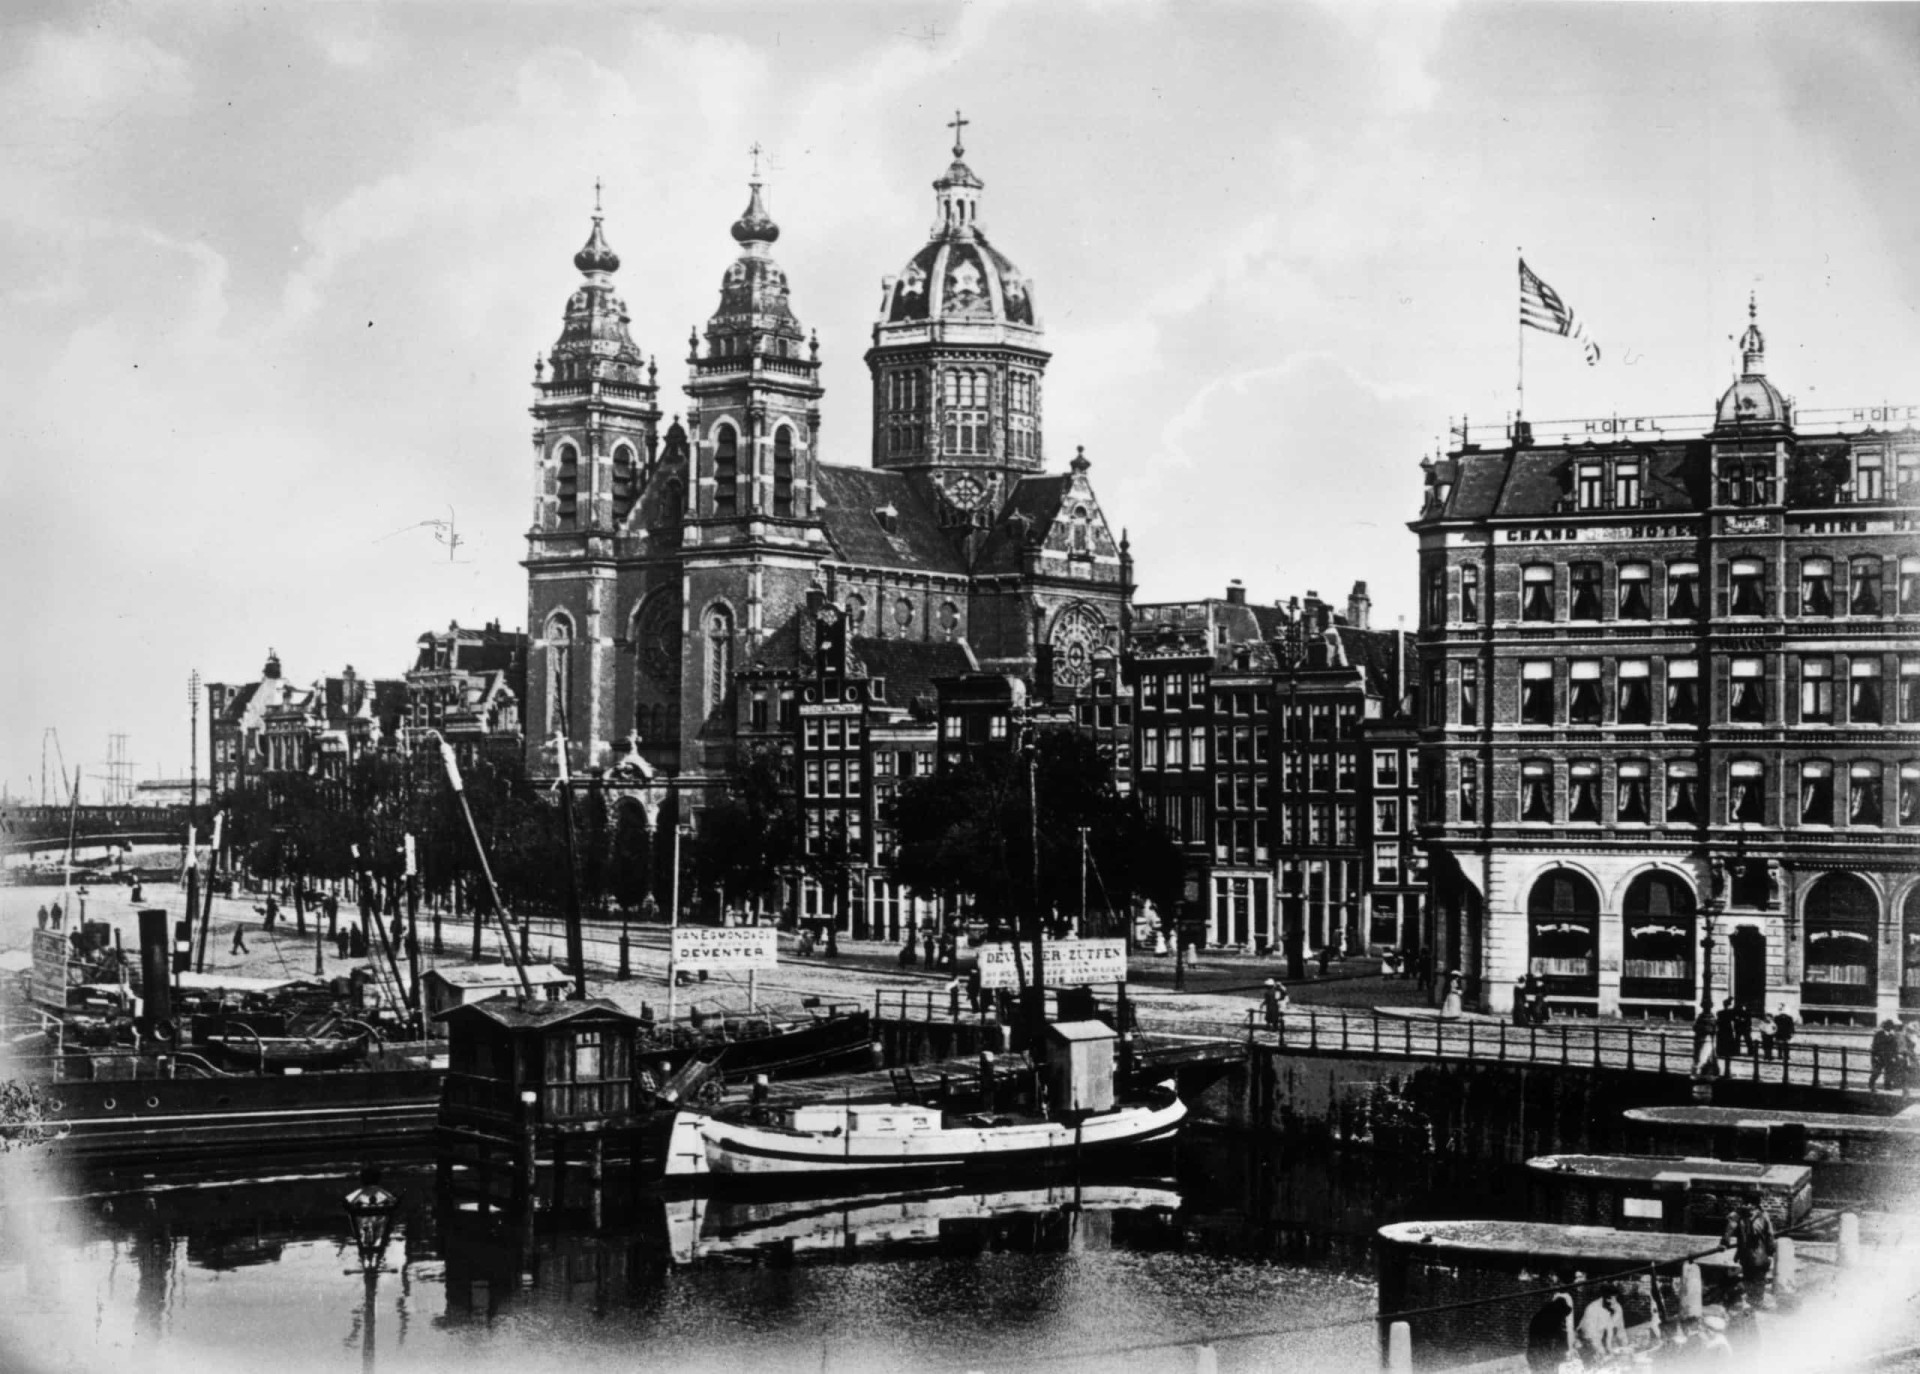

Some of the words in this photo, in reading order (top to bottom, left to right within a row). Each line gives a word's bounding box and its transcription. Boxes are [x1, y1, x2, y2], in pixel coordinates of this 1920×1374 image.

[1585, 418, 1661, 432] HOTEL
[1506, 527, 1577, 541] GRAND
[1632, 525, 1697, 539] HOTEL
[1800, 521, 1867, 533] PRINS
[680, 948, 764, 958] DEVENTER
